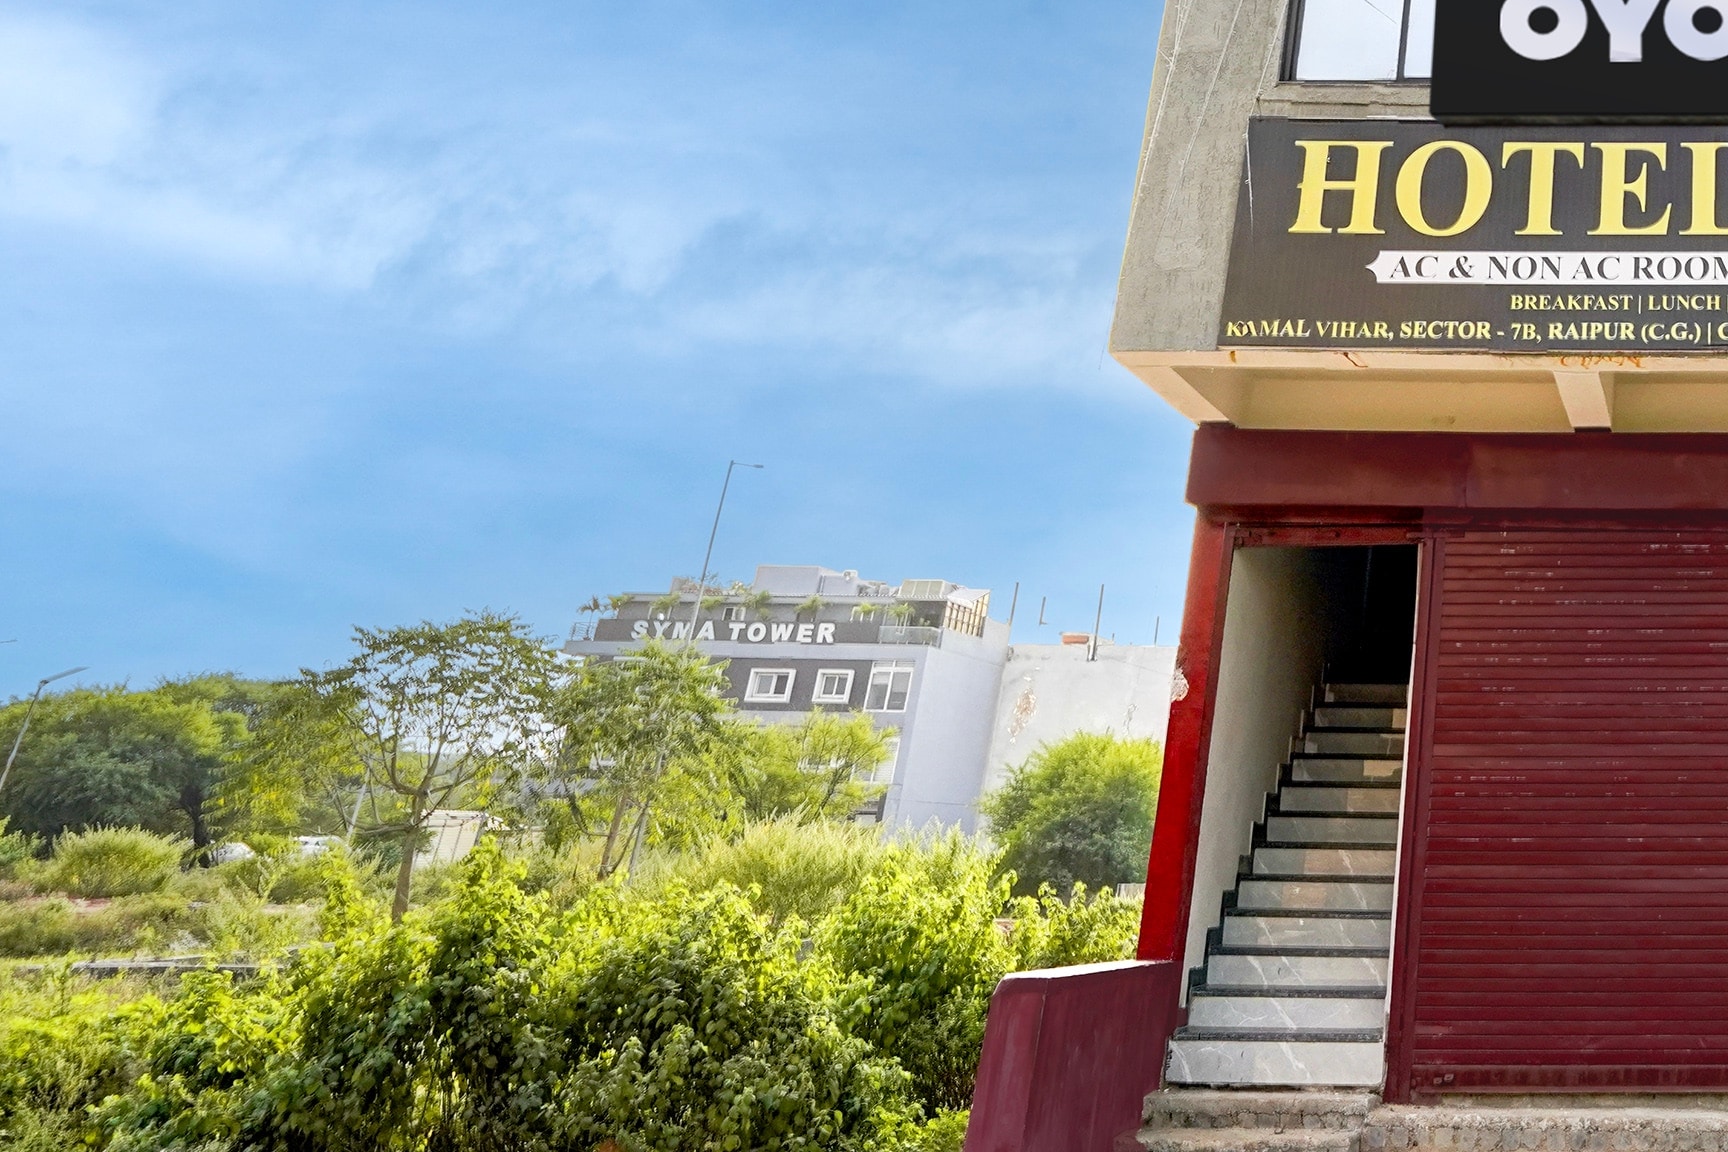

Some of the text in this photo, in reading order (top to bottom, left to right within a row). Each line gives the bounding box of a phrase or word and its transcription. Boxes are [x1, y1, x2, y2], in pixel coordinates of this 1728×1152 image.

[1390, 255, 1439, 279] AC
[1448, 255, 1475, 279] &
[1488, 256, 1561, 280] NON
[1572, 256, 1621, 280] AC
[1510, 295, 1633, 311] BREAKFAST
[1648, 295, 1721, 311] LUNCH
[1315, 321, 1394, 341] VIHAR,
[1400, 321, 1491, 339] SECTOR
[1510, 323, 1542, 343] 7B,
[1548, 322, 1636, 340] RAIPUR
[1641, 323, 1701, 344] (C.G.)
[728, 622, 836, 644] TOWER
